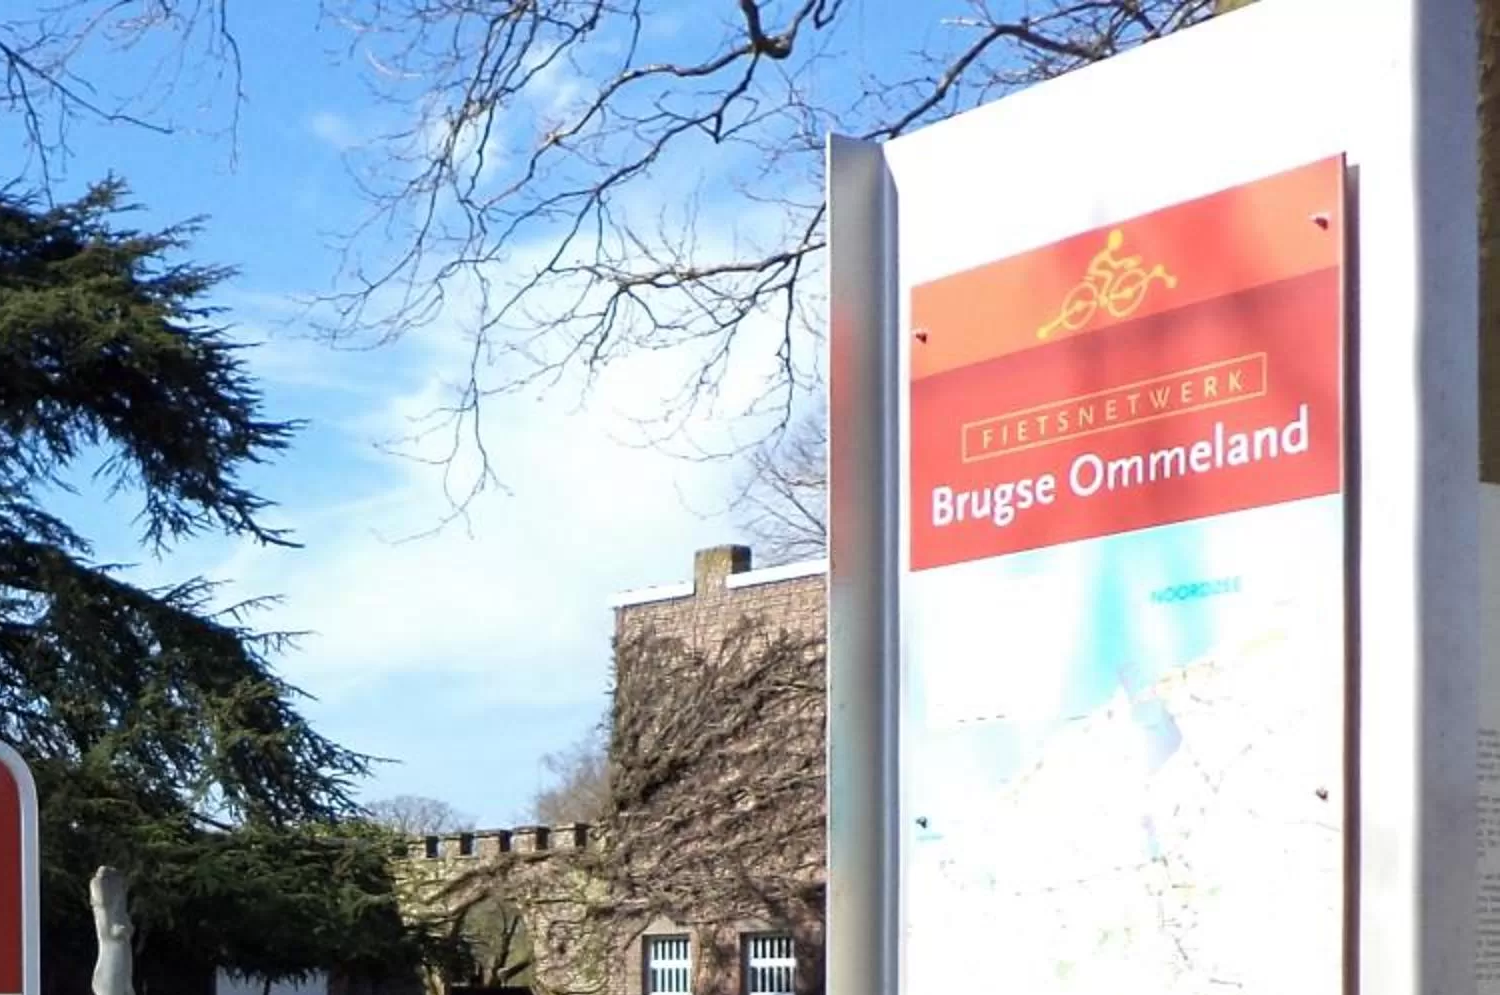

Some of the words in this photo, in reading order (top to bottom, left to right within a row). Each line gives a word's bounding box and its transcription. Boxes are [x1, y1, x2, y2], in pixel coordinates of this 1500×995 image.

[981, 368, 1245, 449] FIETSNETWERK
[931, 473, 1056, 527] Brugse
[1069, 404, 1310, 498] Ommeland
